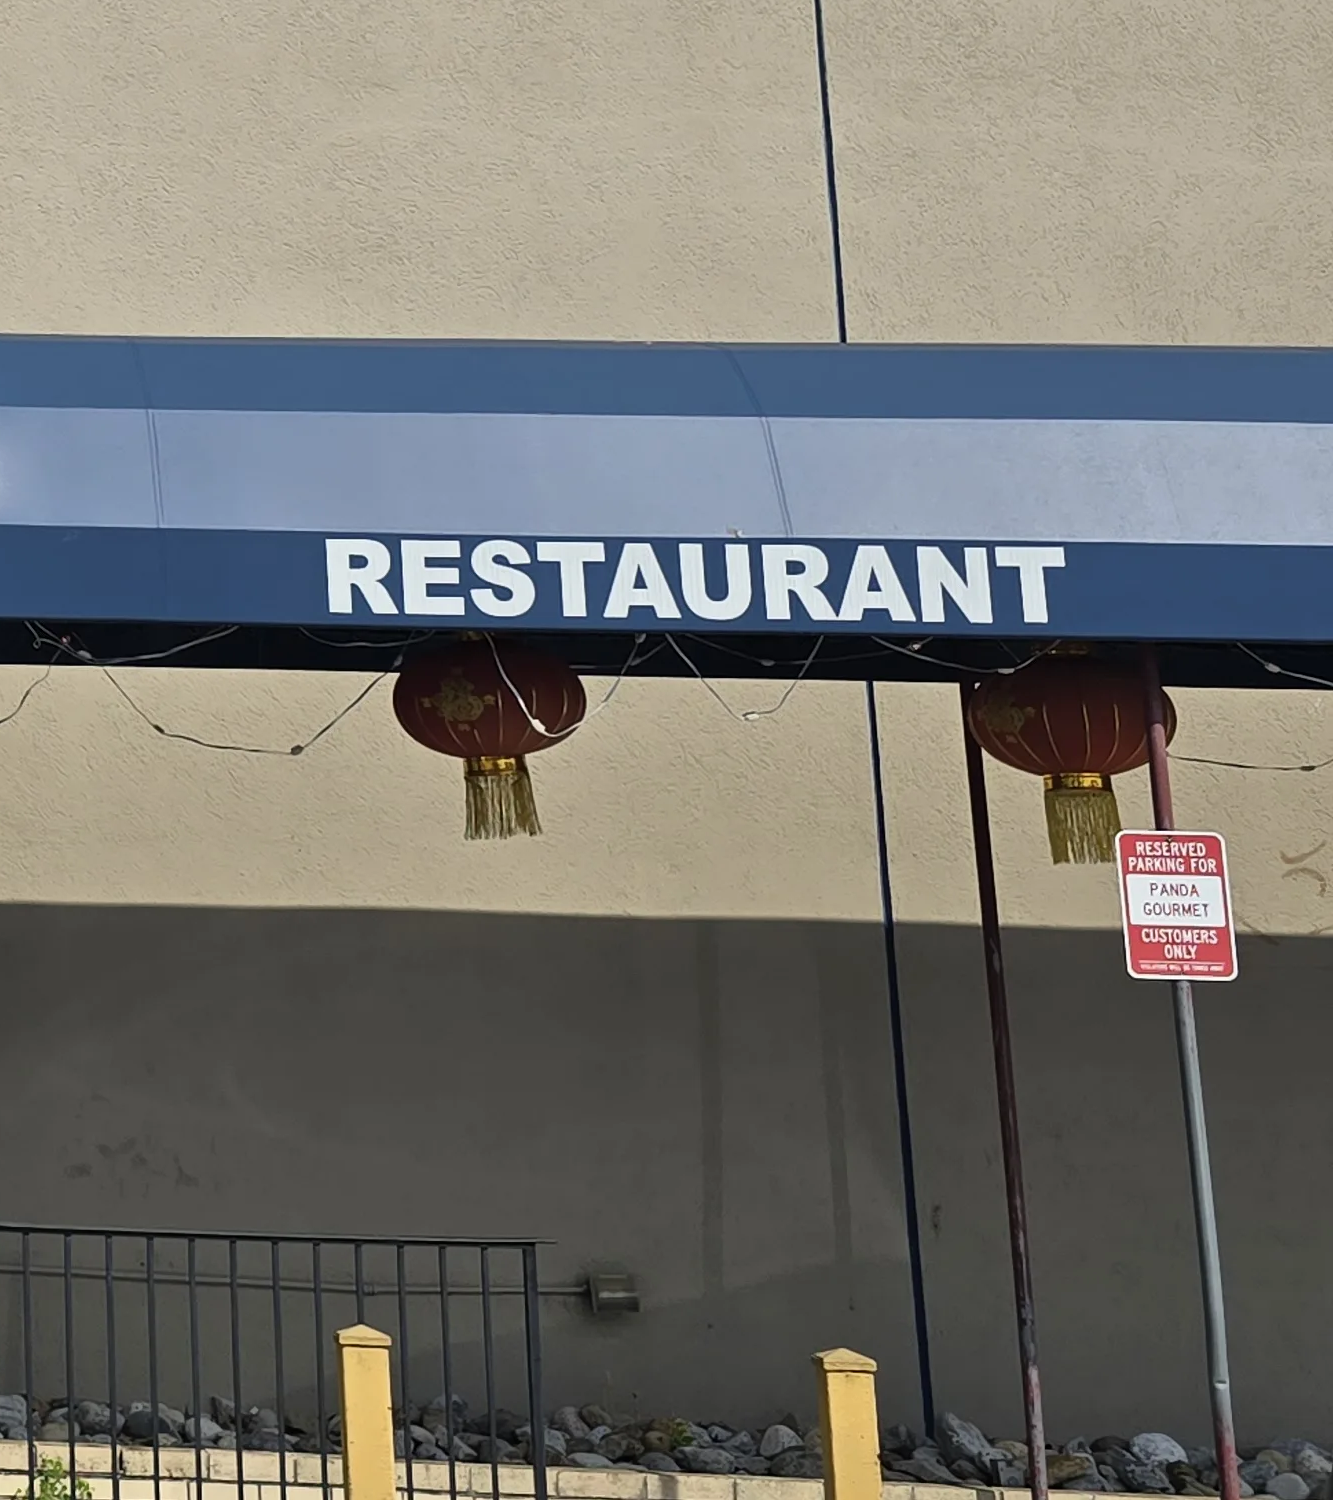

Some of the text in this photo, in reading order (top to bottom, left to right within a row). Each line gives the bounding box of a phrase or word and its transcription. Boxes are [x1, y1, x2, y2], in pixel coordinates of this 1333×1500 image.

[324, 538, 1066, 625] RESTAURANT
[1135, 841, 1206, 857] RESERVED
[1128, 857, 1217, 873] PARKING FOR
[1149, 882, 1200, 897] PANDA
[1143, 902, 1210, 917] GOURMET
[1141, 928, 1218, 944] CUSTOMERS
[1164, 945, 1198, 960] ONLY
